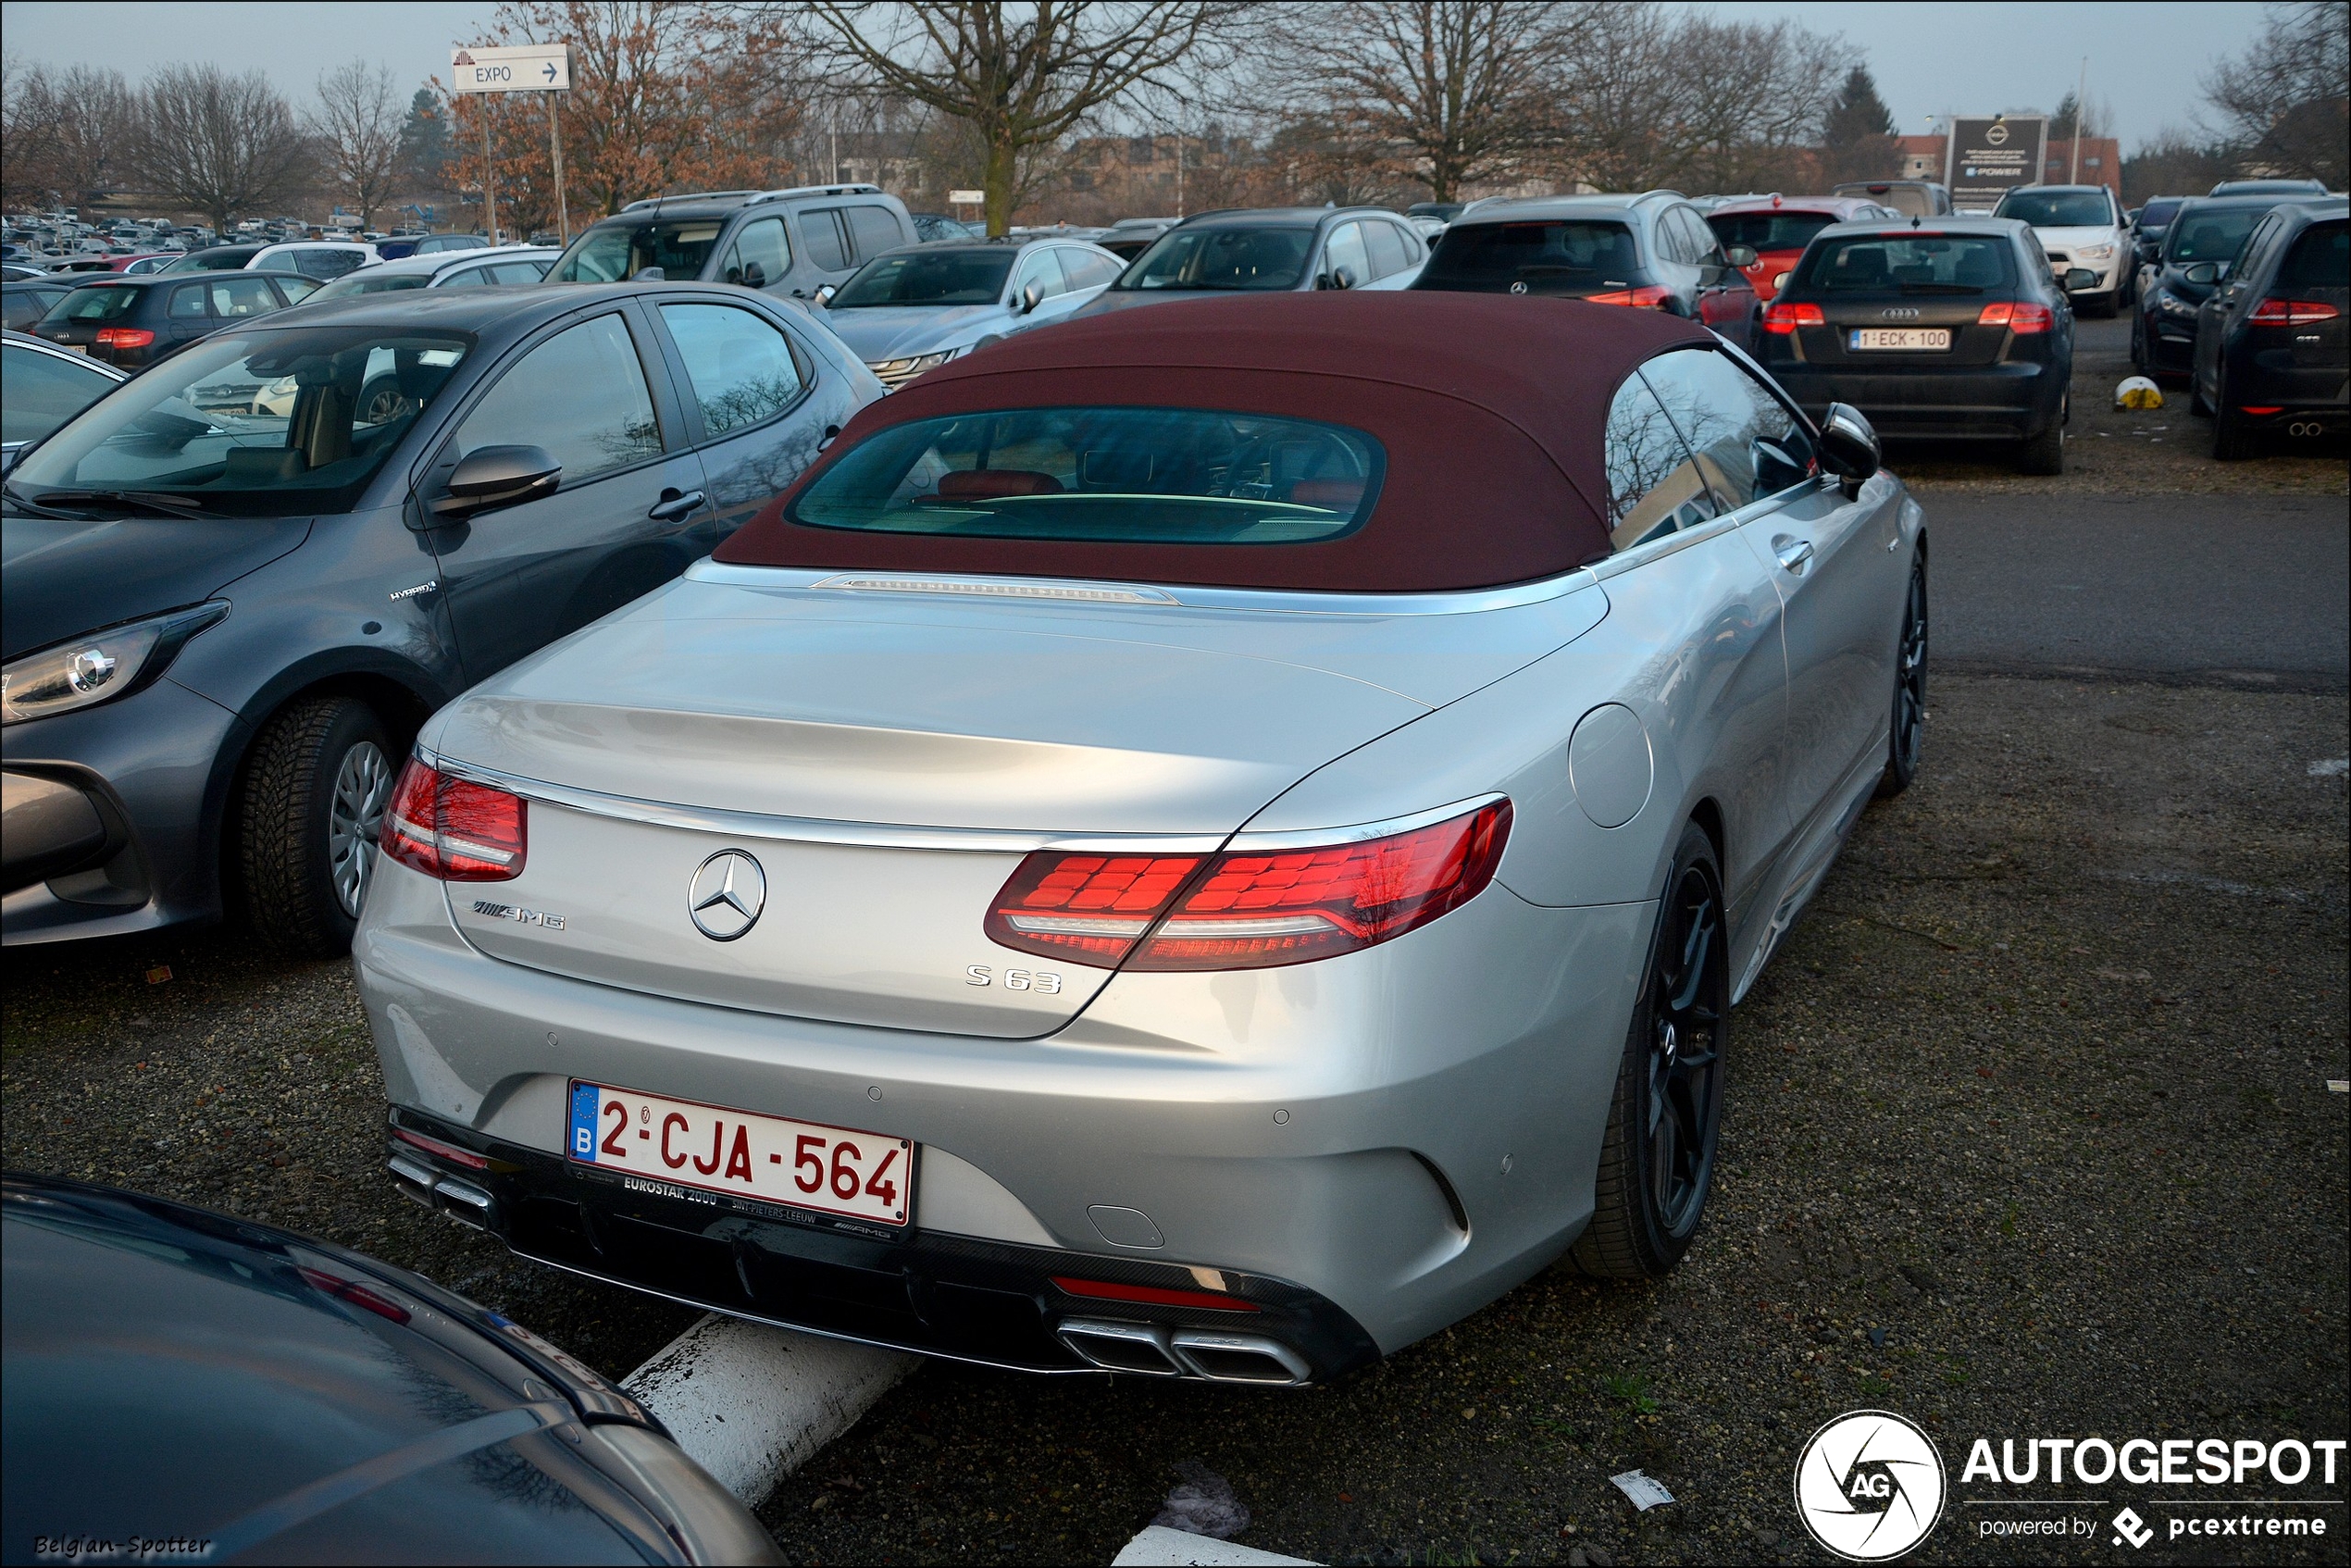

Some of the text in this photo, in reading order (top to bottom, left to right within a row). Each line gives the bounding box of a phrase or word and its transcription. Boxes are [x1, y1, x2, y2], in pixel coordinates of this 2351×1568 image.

[476, 66, 511, 82] EXPO
[1862, 331, 1947, 346] 1-ECK-100
[390, 583, 429, 602] HYBRID
[499, 906, 566, 930] AMG
[965, 964, 1062, 995] S 63
[577, 1100, 900, 1207] B 2-CJA-564
[624, 1176, 685, 1200] EUROSTAR
[688, 1190, 717, 1206] 2000
[731, 1200, 816, 1224] SINT-PIETERS-LEEUW
[852, 1225, 891, 1239] AMG
